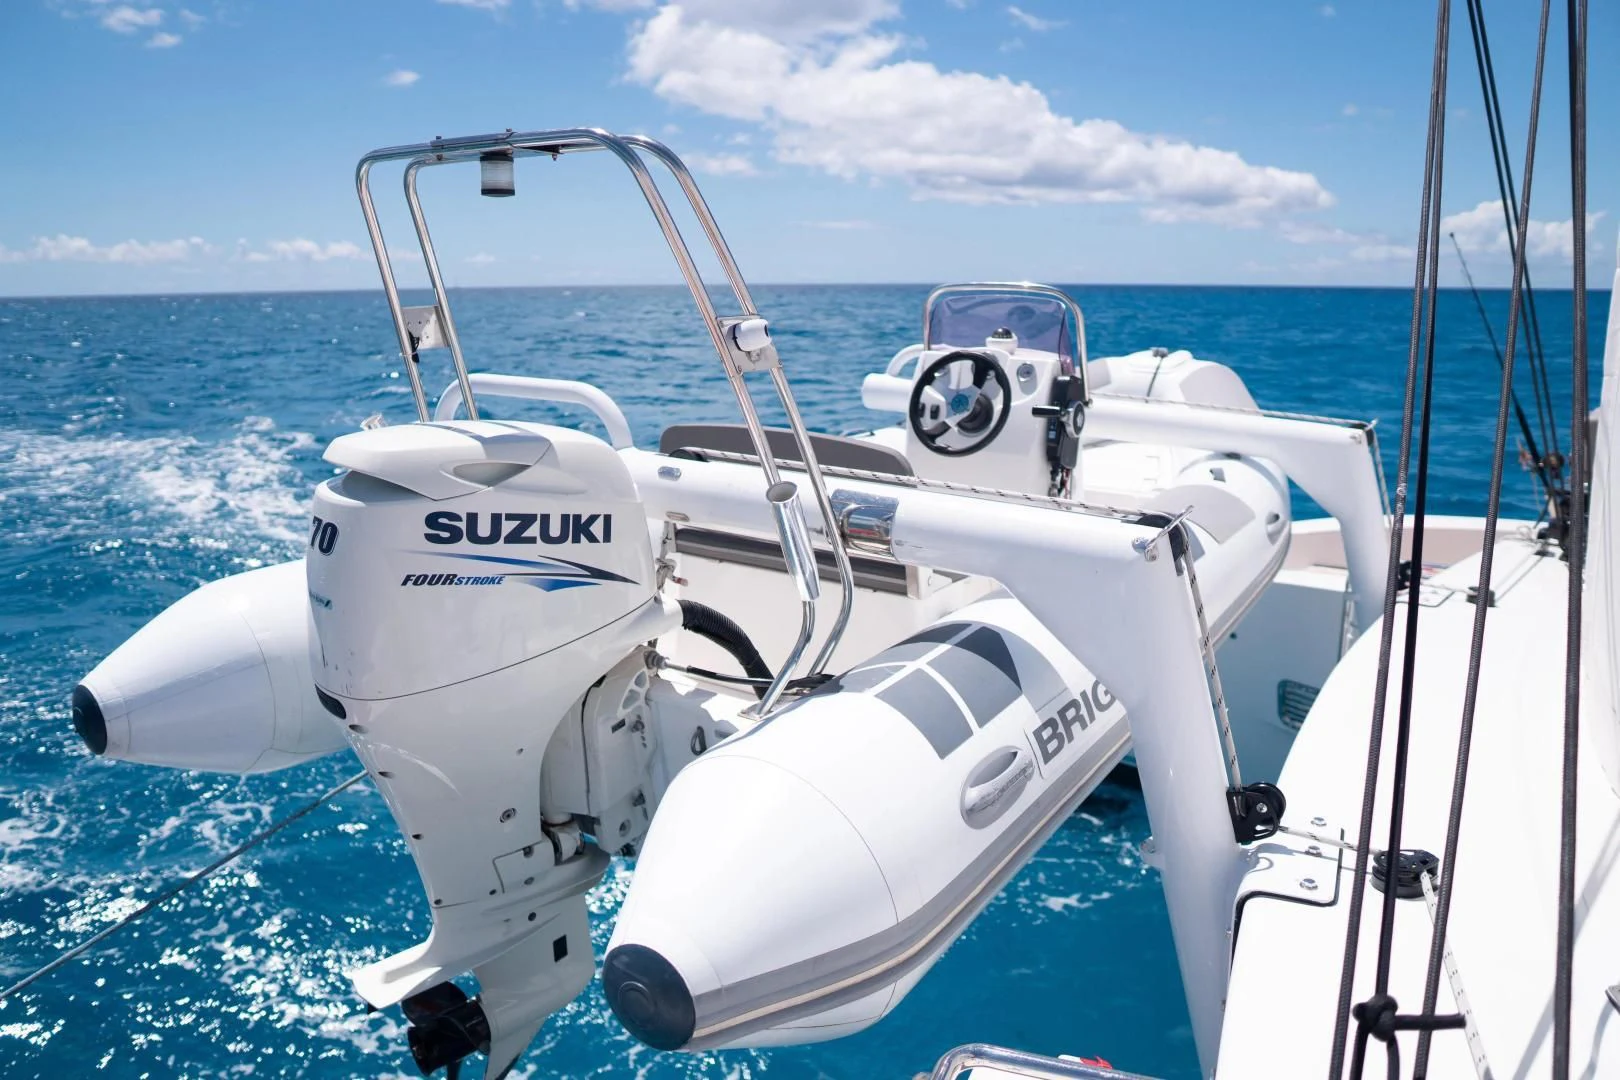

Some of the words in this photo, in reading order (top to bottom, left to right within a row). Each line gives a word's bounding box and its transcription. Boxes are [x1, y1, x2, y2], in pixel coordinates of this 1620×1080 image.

[310, 516, 339, 556] 70
[424, 511, 612, 545] SUZUKI
[1032, 679, 1116, 766] BRIG
